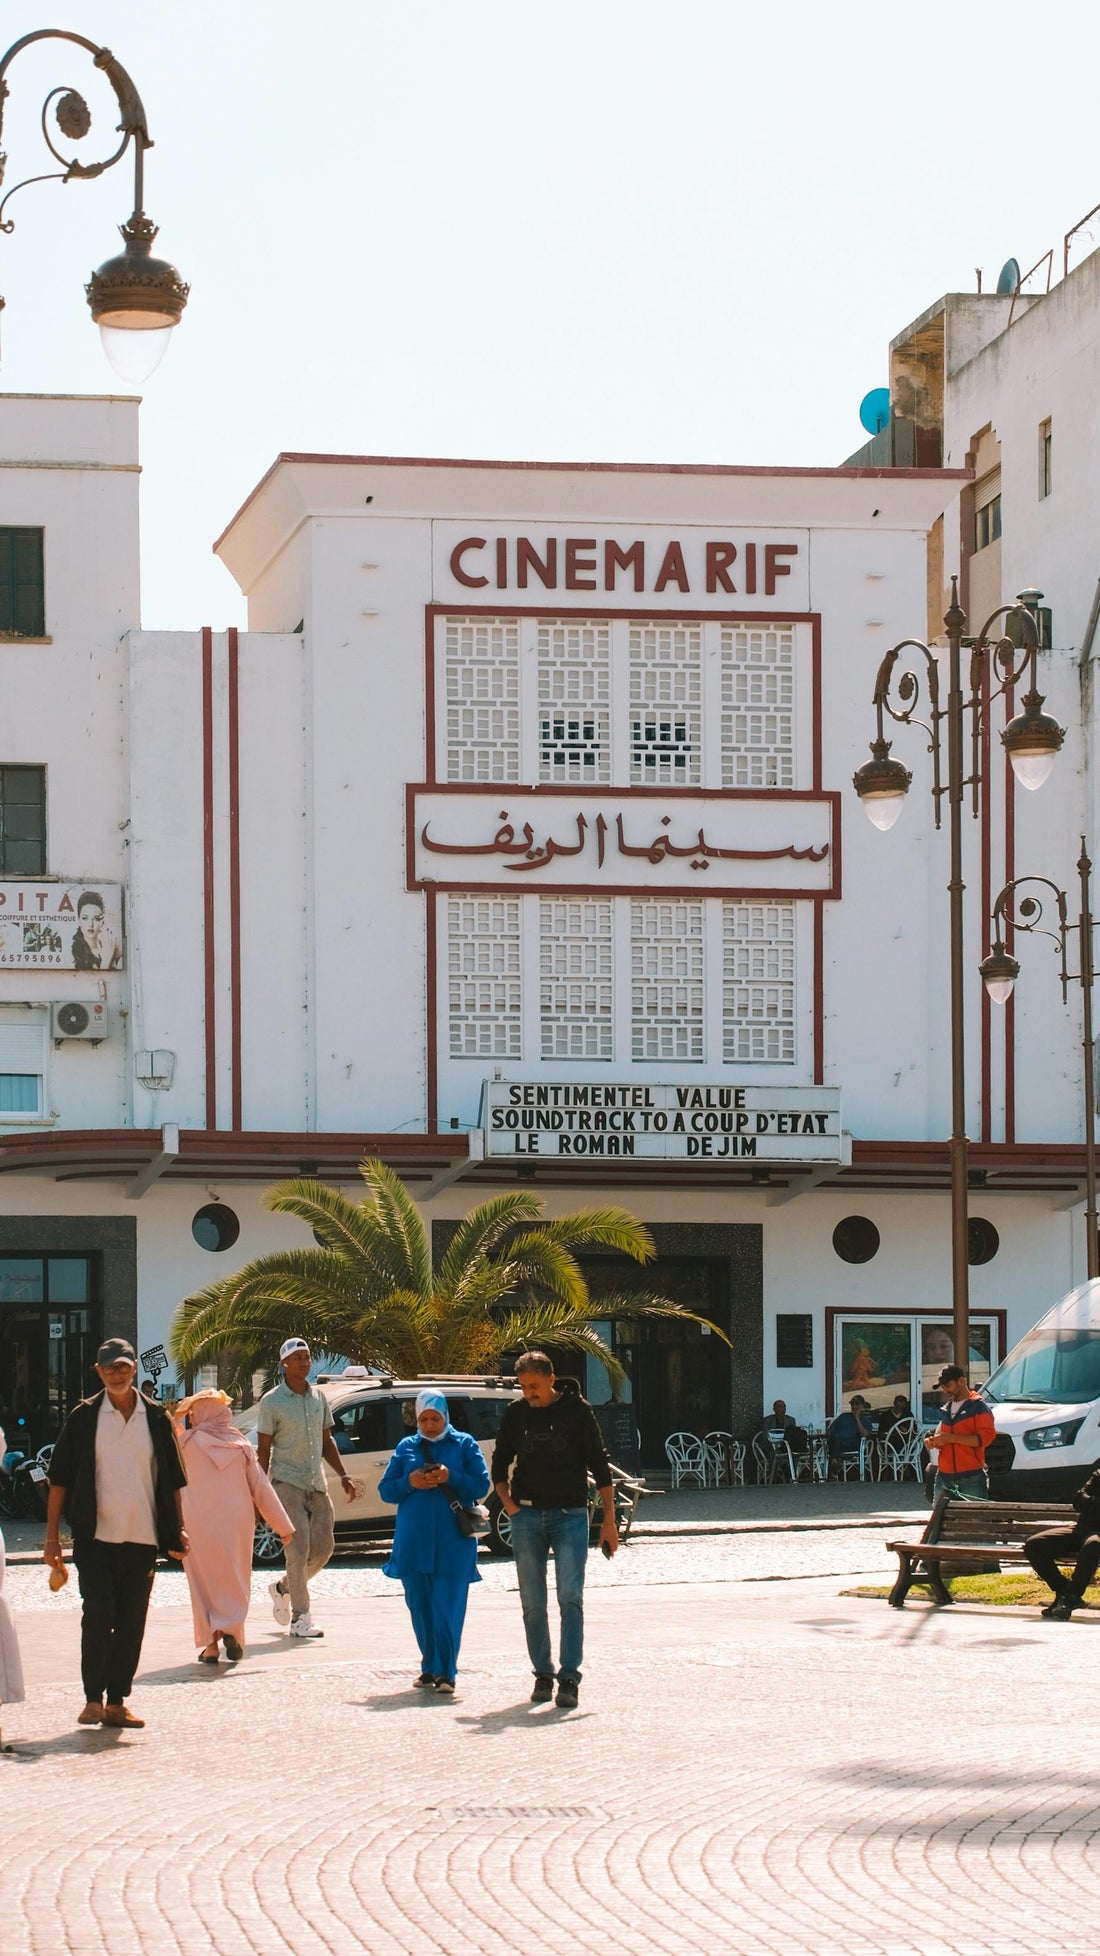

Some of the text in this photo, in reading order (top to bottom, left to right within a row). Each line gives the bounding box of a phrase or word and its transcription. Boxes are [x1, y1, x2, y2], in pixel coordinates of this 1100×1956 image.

[450, 537, 798, 595] CINEMA RIF
[421, 810, 829, 870] سينما الريف
[509, 1085, 746, 1108] SENTIMENTEL VALUE
[491, 1109, 828, 1134] SOUNDTRACK TO A COUP D'ETAT
[515, 1133, 757, 1157] LE ROMAN DE JIM
